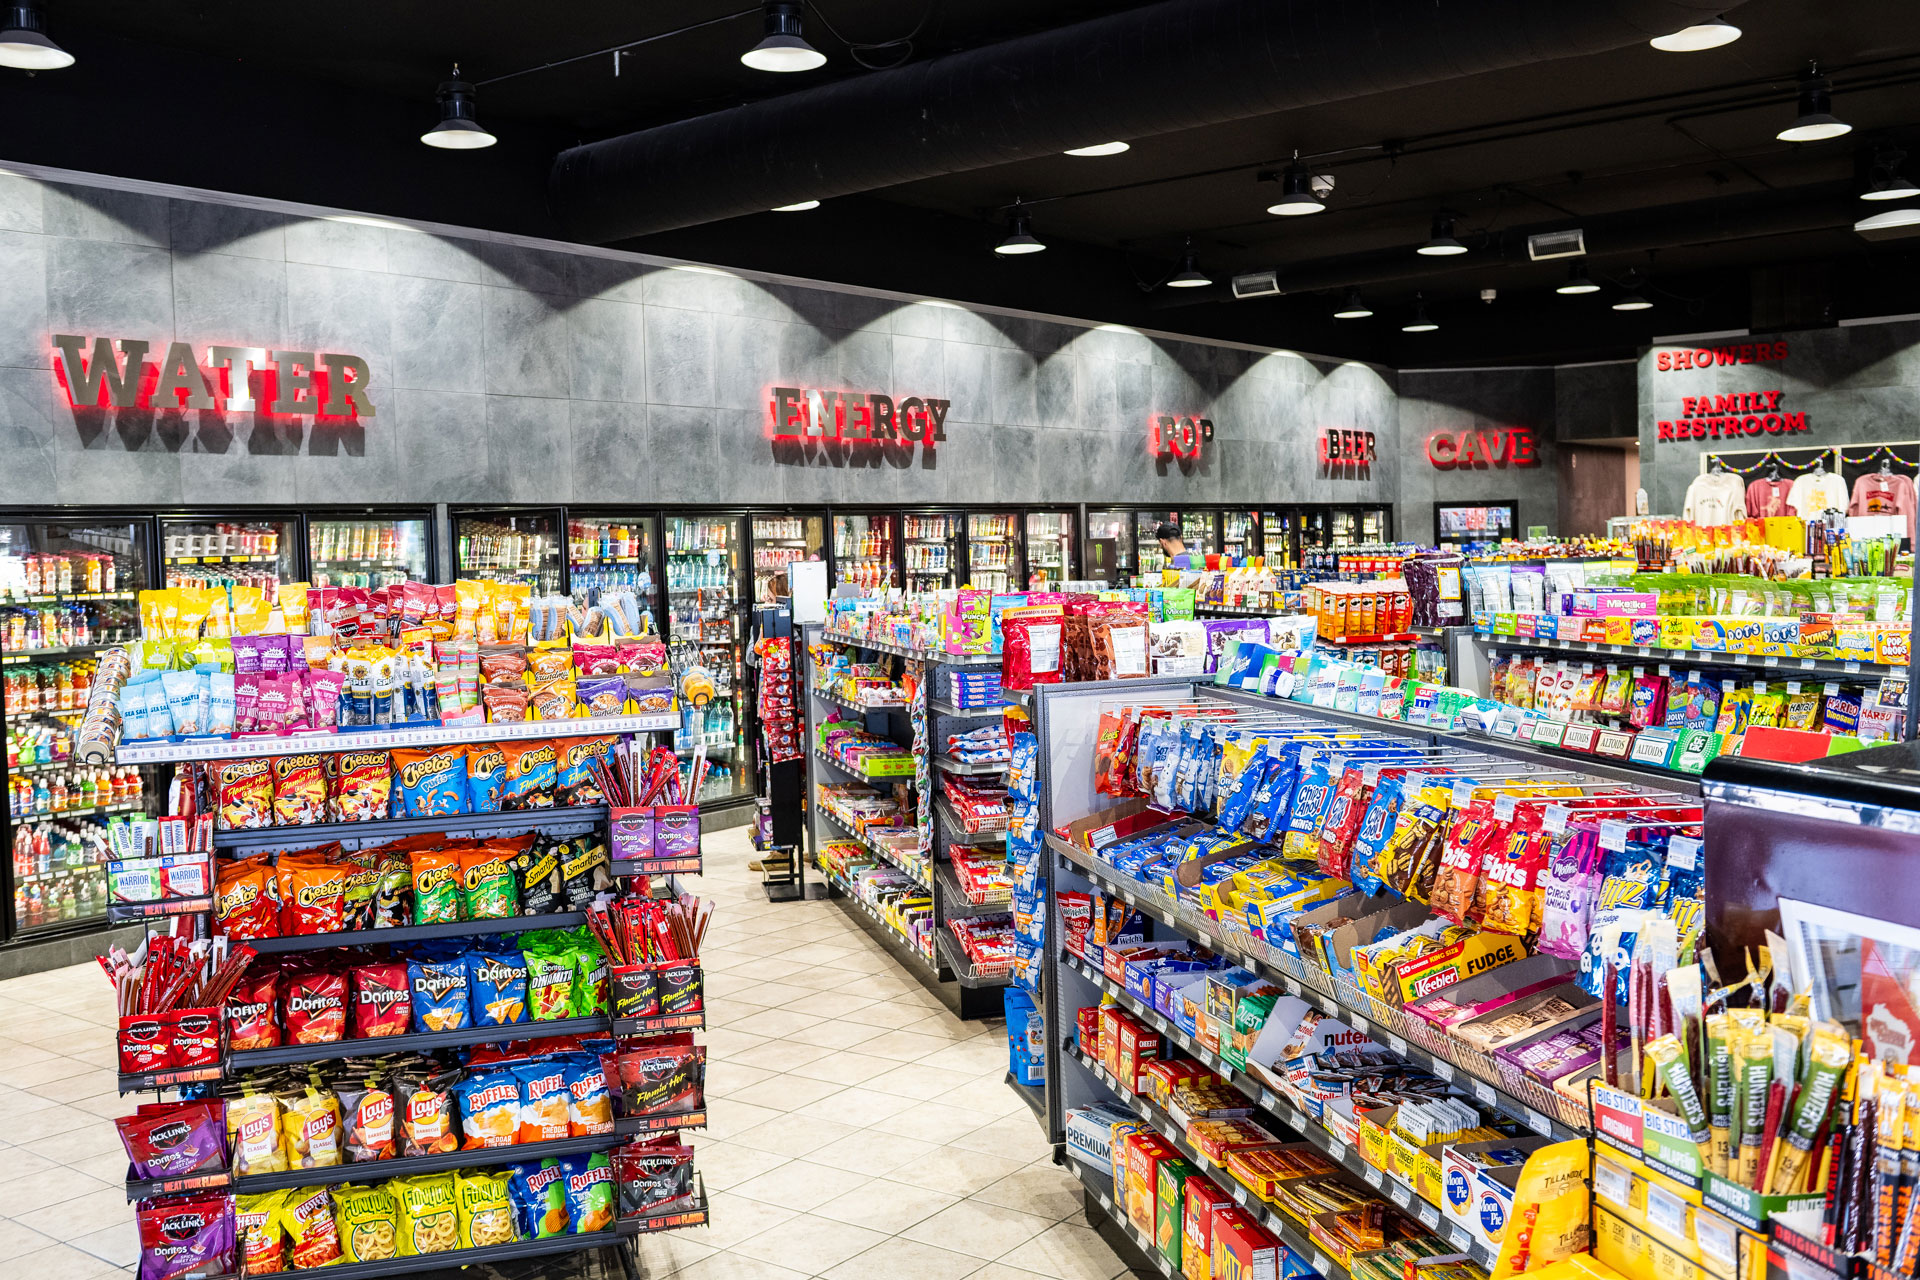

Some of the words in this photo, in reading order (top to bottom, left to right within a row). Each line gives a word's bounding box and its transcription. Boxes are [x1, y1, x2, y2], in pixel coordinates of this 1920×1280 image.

[1657, 341, 1789, 371] SHOWERS
[52, 334, 376, 417] WATER
[1682, 390, 1781, 416] FAMILY
[771, 386, 950, 441] ENERGY
[1156, 416, 1214, 453] POP
[1657, 411, 1808, 440] RESTROOM
[1325, 428, 1377, 461] BEER
[1429, 429, 1535, 466] CAVE
[961, 613, 987, 621] PUNCH
[1727, 623, 1761, 641] DOTS
[1764, 625, 1797, 644] DOTS
[1800, 631, 1829, 646] Crows
[1886, 637, 1903, 647] POP
[1882, 645, 1908, 656] DROPS
[1358, 689, 1379, 698] mentos
[1381, 692, 1403, 700] mentos
[1828, 696, 1859, 716] HARIBO
[1861, 709, 1893, 721] HARIBO
[1666, 713, 1686, 723] JOLLY
[1686, 720, 1706, 730] JOLLY
[1537, 725, 1560, 738] ALTOIDS
[1568, 731, 1590, 744] ALTOIDS
[1693, 736, 1706, 745] tic
[1600, 737, 1625, 749] ALTOIDS
[1636, 744, 1664, 758] ALTOIDS
[1689, 743, 1703, 753] tac
[275, 753, 322, 779] Cheetos
[341, 752, 388, 776] Cheetos
[519, 746, 556, 775] Cheeto
[222, 760, 270, 785] Cheetos
[402, 753, 453, 789] Cheetos
[1299, 785, 1324, 805] Chips
[1291, 818, 1313, 831] MINIS
[613, 834, 639, 842] Doritos
[1507, 832, 1530, 856] RITZ
[1165, 845, 1182, 855] OREO
[1441, 842, 1472, 870] bits
[119, 874, 149, 886] WARRIOR
[170, 869, 201, 881] WARRIOR
[344, 870, 382, 892] Cheetos
[464, 858, 509, 892] Cheetos
[1488, 859, 1528, 887] bits
[299, 880, 344, 907] Cheetos
[570, 891, 594, 902] CHEDDAR
[571, 886, 589, 895] WHITE
[1546, 886, 1571, 901] CIRCUS
[1545, 897, 1569, 912] ANIMAL
[1118, 934, 1143, 945] Welch's
[542, 964, 565, 974] Doritos
[1400, 965, 1411, 976] 10
[1429, 952, 1446, 964] KING
[1445, 946, 1460, 958] SIZE
[1466, 944, 1516, 975] FUDGE
[415, 974, 468, 994] Doritos
[477, 965, 528, 983] Doritos
[531, 969, 574, 989] DINAMITA
[1415, 966, 1459, 998] Keebler
[290, 996, 342, 1012] Doritos
[360, 988, 411, 1005] Doritos
[1236, 1005, 1263, 1031] QUEST
[122, 1044, 151, 1053] Doritos
[173, 1037, 201, 1047] Doritos
[1138, 1038, 1157, 1049] CHEEZ-IT
[638, 1063, 657, 1074] JACK
[656, 1060, 678, 1070] LINK'S
[155, 1073, 174, 1085] MEAT
[174, 1071, 194, 1083] YOUR
[469, 1085, 520, 1112] RUFFLES
[1597, 1088, 1612, 1105] BIG
[1614, 1096, 1640, 1114] STICK
[1669, 1063, 1705, 1125] HUNTER'S
[1749, 1064, 1768, 1127] HUNTER'S
[1797, 1072, 1837, 1133] HUNTER'S
[361, 1097, 394, 1125] Lay's
[411, 1096, 443, 1120] Lay's
[241, 1116, 270, 1141] Lay's
[307, 1113, 335, 1137] Lay's
[541, 1124, 568, 1135] CHEDDAR
[650, 1118, 667, 1129] MEAT
[667, 1117, 682, 1127] YOUR
[1601, 1115, 1635, 1143] ORIGINAL
[148, 1131, 168, 1145] JACK
[167, 1124, 192, 1140] LINK'S
[484, 1135, 512, 1146] CHEDDAR
[1067, 1127, 1111, 1161] PREMIUM
[1364, 1126, 1384, 1147] STINGER
[1596, 1131, 1617, 1148] SMOKED
[1617, 1140, 1642, 1158] SAUSAGES
[246, 1144, 268, 1154] CLASSIC
[312, 1140, 334, 1150] CLASSIC
[1717, 1140, 1728, 1152] 13
[147, 1151, 181, 1167] Doritos
[1131, 1146, 1148, 1167] TOWN
[1394, 1146, 1414, 1168] STINGER
[1746, 1158, 1757, 1170] 13
[1130, 1161, 1149, 1183] HOUSE
[1645, 1156, 1667, 1174] SMOKED
[1667, 1166, 1696, 1186] SAUSAGES
[1825, 1133, 1843, 1209] ORIGINAL
[164, 1180, 183, 1192] MEAT
[183, 1178, 203, 1190] YOUR
[632, 1180, 661, 1188] Doritos
[1158, 1175, 1176, 1207] CLUB
[1456, 1185, 1467, 1199] Pie
[1710, 1177, 1751, 1211] HUNTER'S
[402, 1181, 455, 1209] FUNYUNS
[343, 1191, 394, 1222] FUNYUNS
[1703, 1194, 1727, 1214] SMOKED
[1726, 1205, 1758, 1231] SAUSAGES
[160, 1220, 182, 1232] JACK
[181, 1217, 205, 1229] LINK'S
[648, 1219, 665, 1229] MEAT
[665, 1217, 681, 1228] YOUR
[1490, 1212, 1503, 1226] Pie
[1185, 1212, 1206, 1250] bits
[154, 1245, 188, 1257] Doritos
[1774, 1224, 1836, 1269] ORIGINAL
[1221, 1242, 1242, 1280] RITZ
